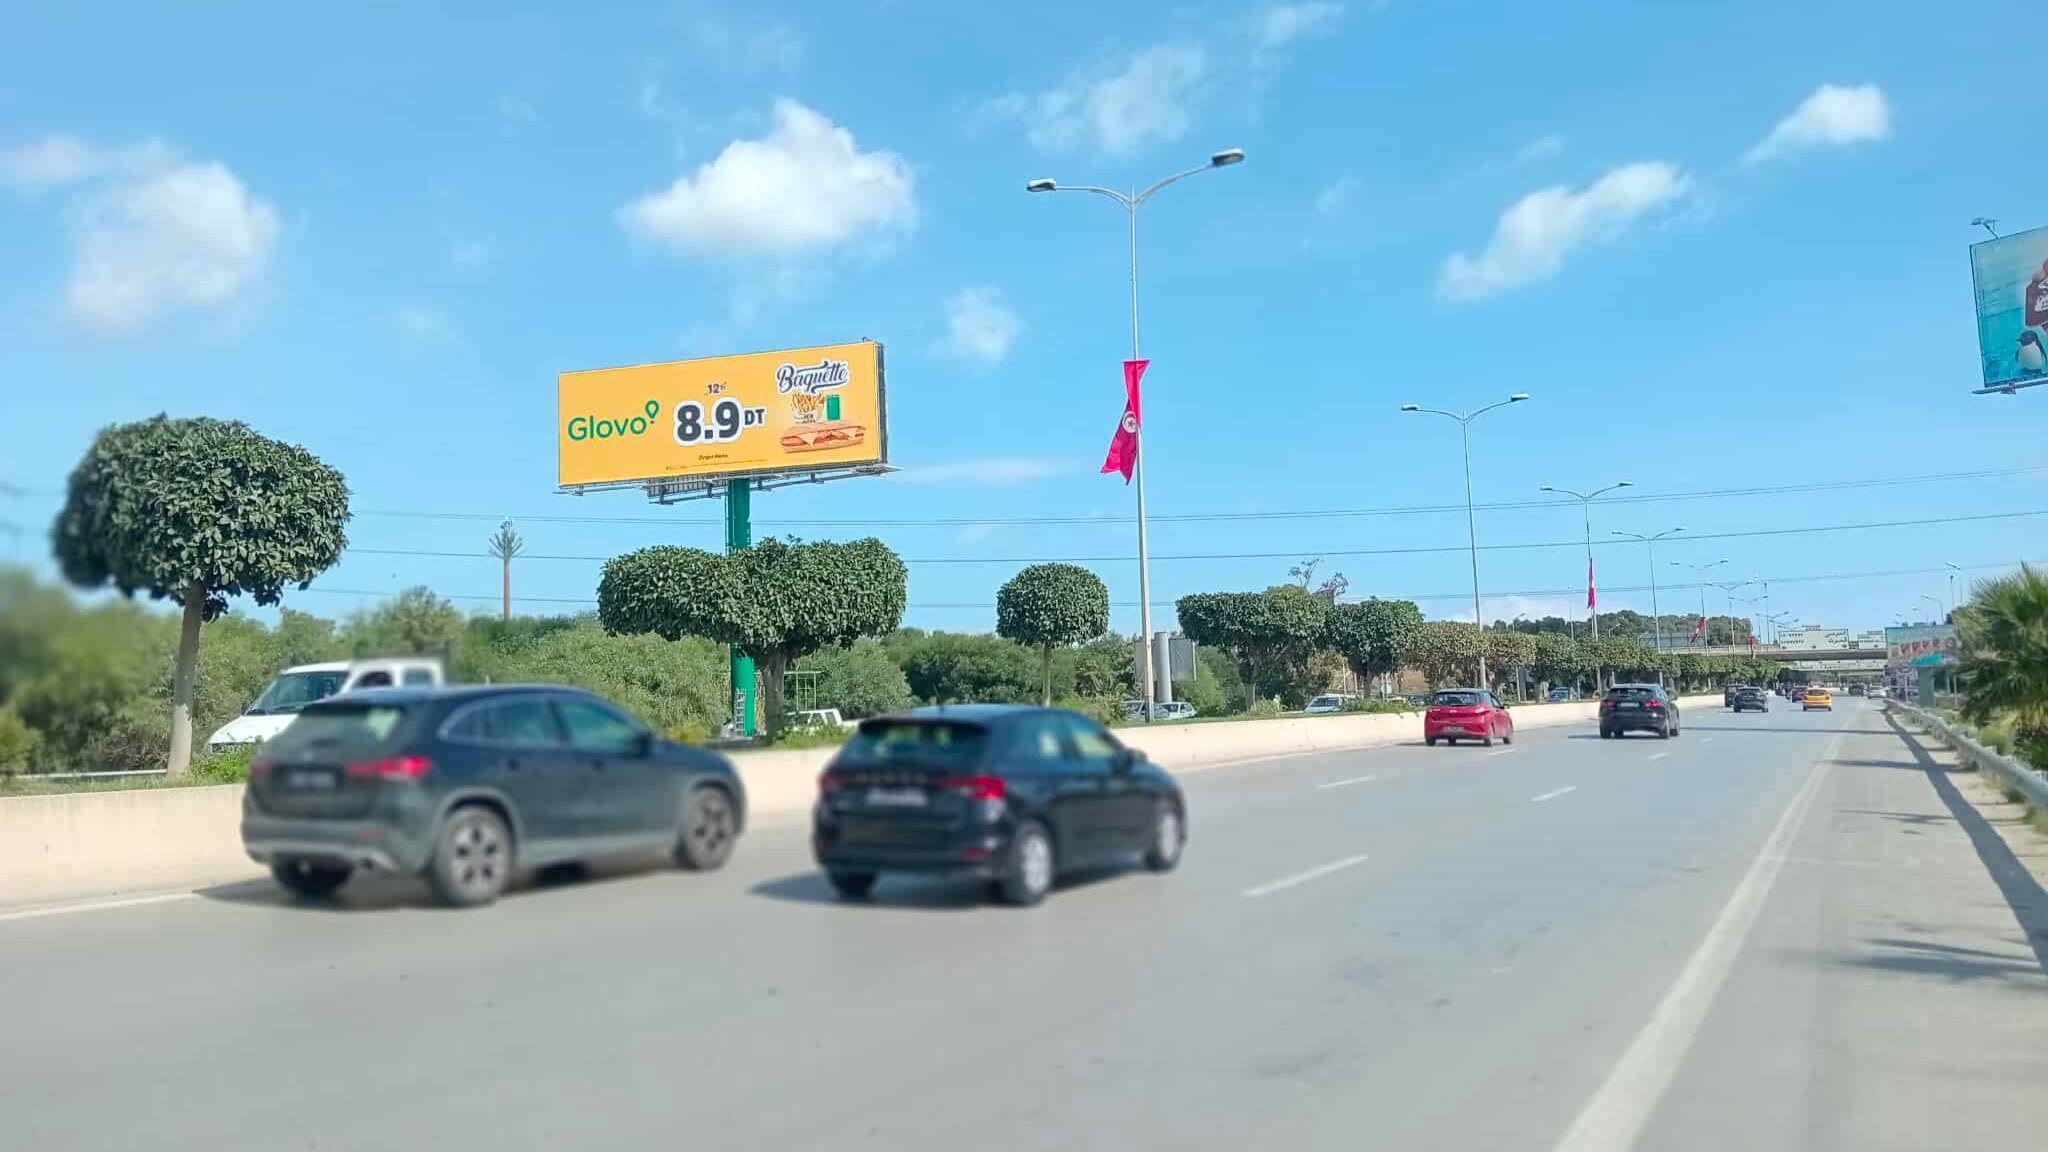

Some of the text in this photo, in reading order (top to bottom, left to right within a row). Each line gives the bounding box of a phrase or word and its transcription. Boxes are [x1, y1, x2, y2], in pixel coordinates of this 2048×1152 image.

[777, 360, 847, 394] Baguette
[567, 414, 647, 441] Glovo
[676, 400, 766, 442] 8.9 DT
